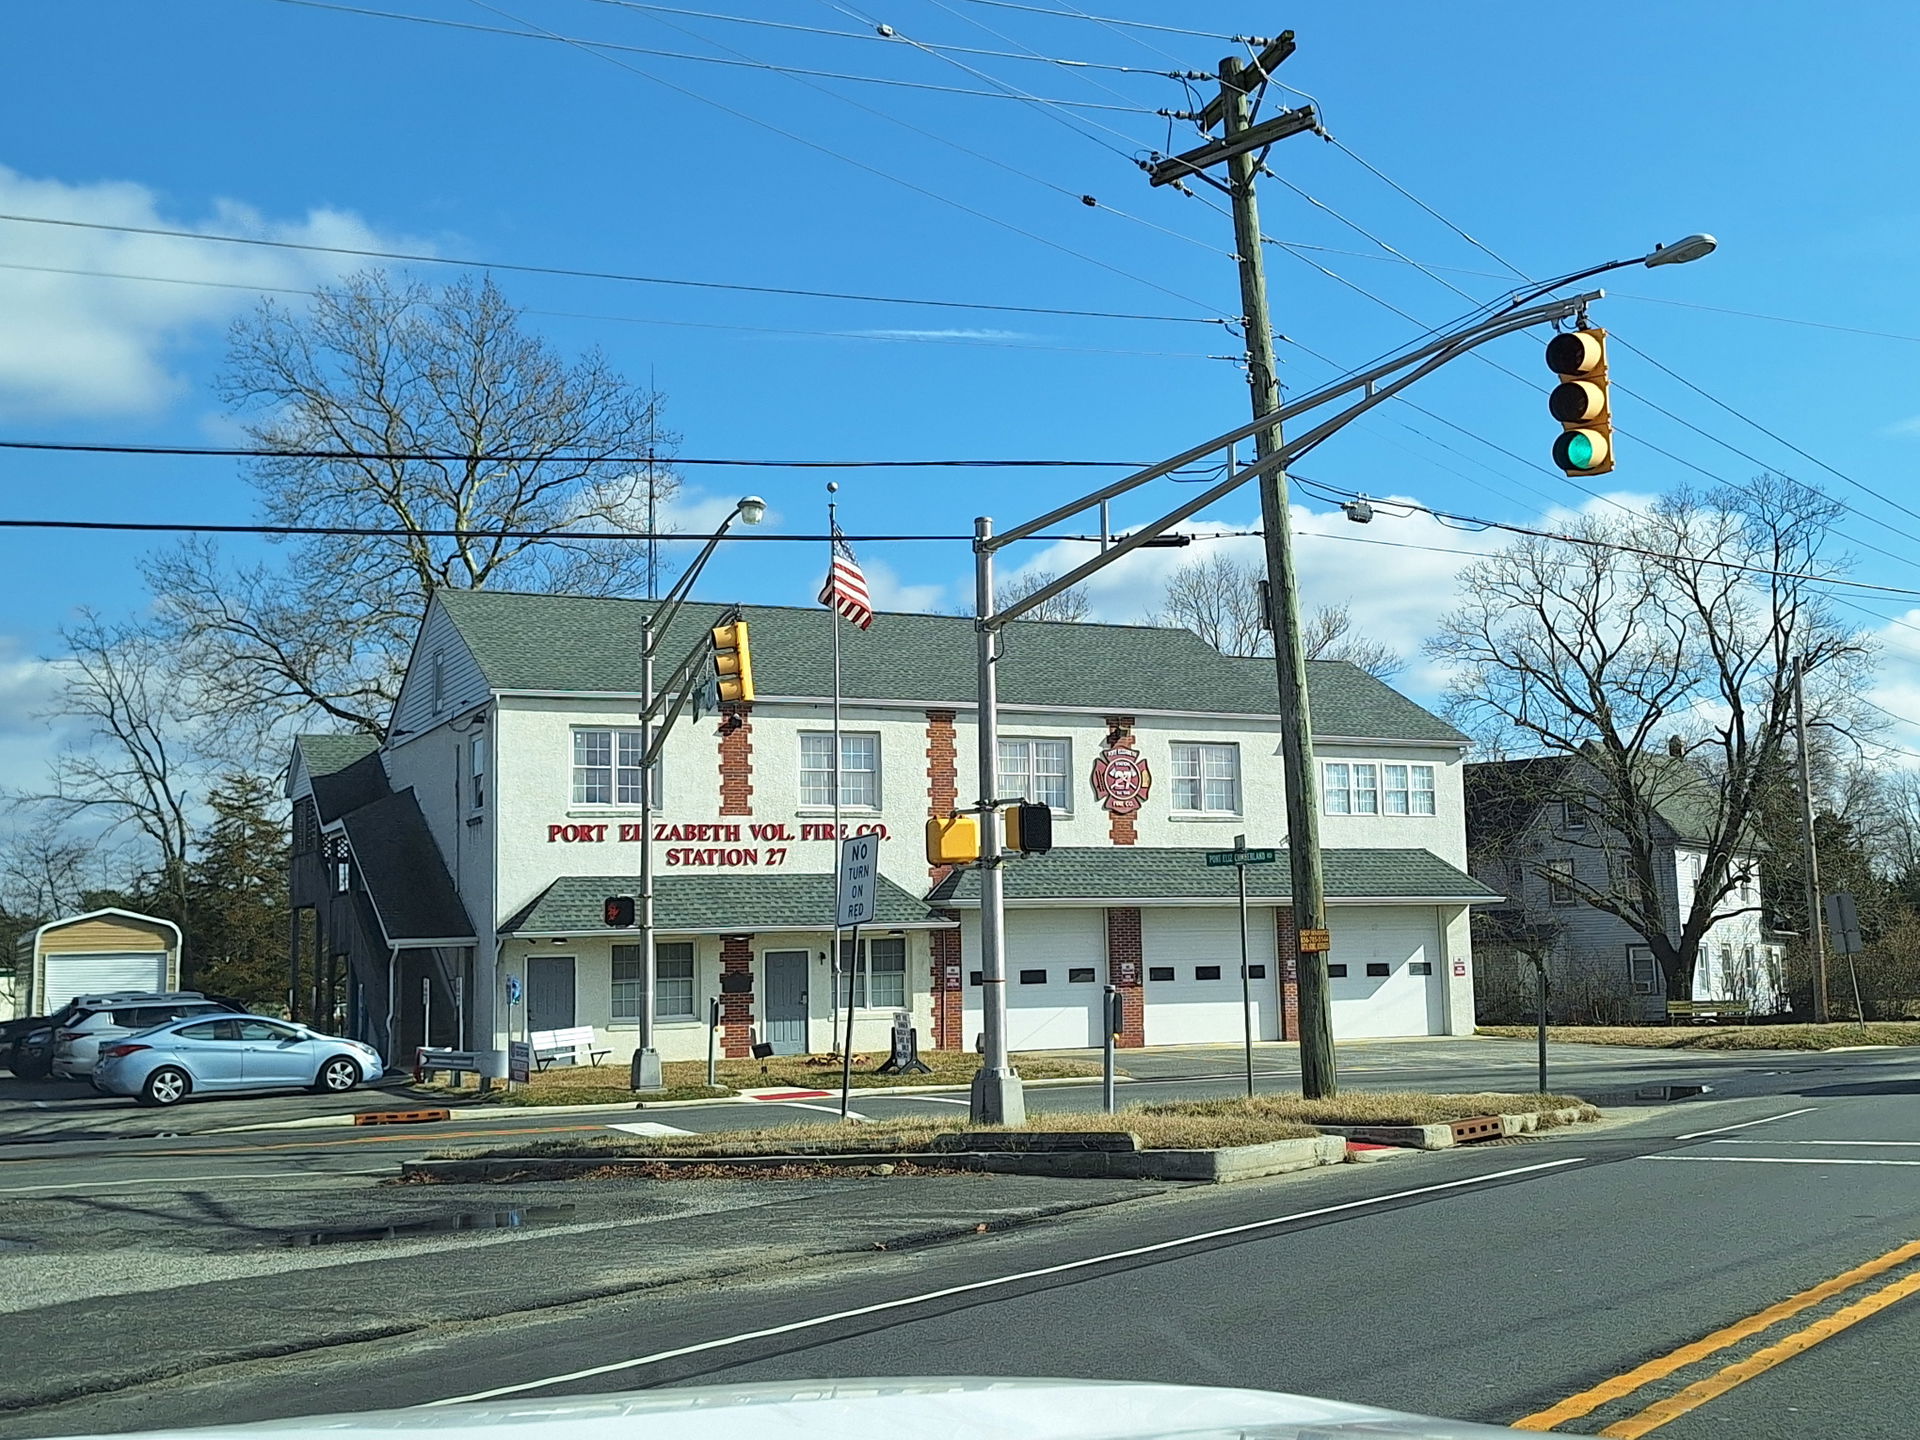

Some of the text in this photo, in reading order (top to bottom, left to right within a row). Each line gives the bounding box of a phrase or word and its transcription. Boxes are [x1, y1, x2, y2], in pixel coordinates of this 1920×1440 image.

[1114, 770, 1132, 790] 27
[547, 824, 609, 843] PORT
[618, 823, 741, 842] ELZABETH
[748, 823, 796, 842] VOL.
[800, 823, 850, 842] FIRE
[665, 848, 787, 866] STATION 27
[852, 843, 868, 862] NO
[848, 864, 870, 880] TURN
[851, 883, 864, 899] ON
[847, 903, 864, 918] RED
